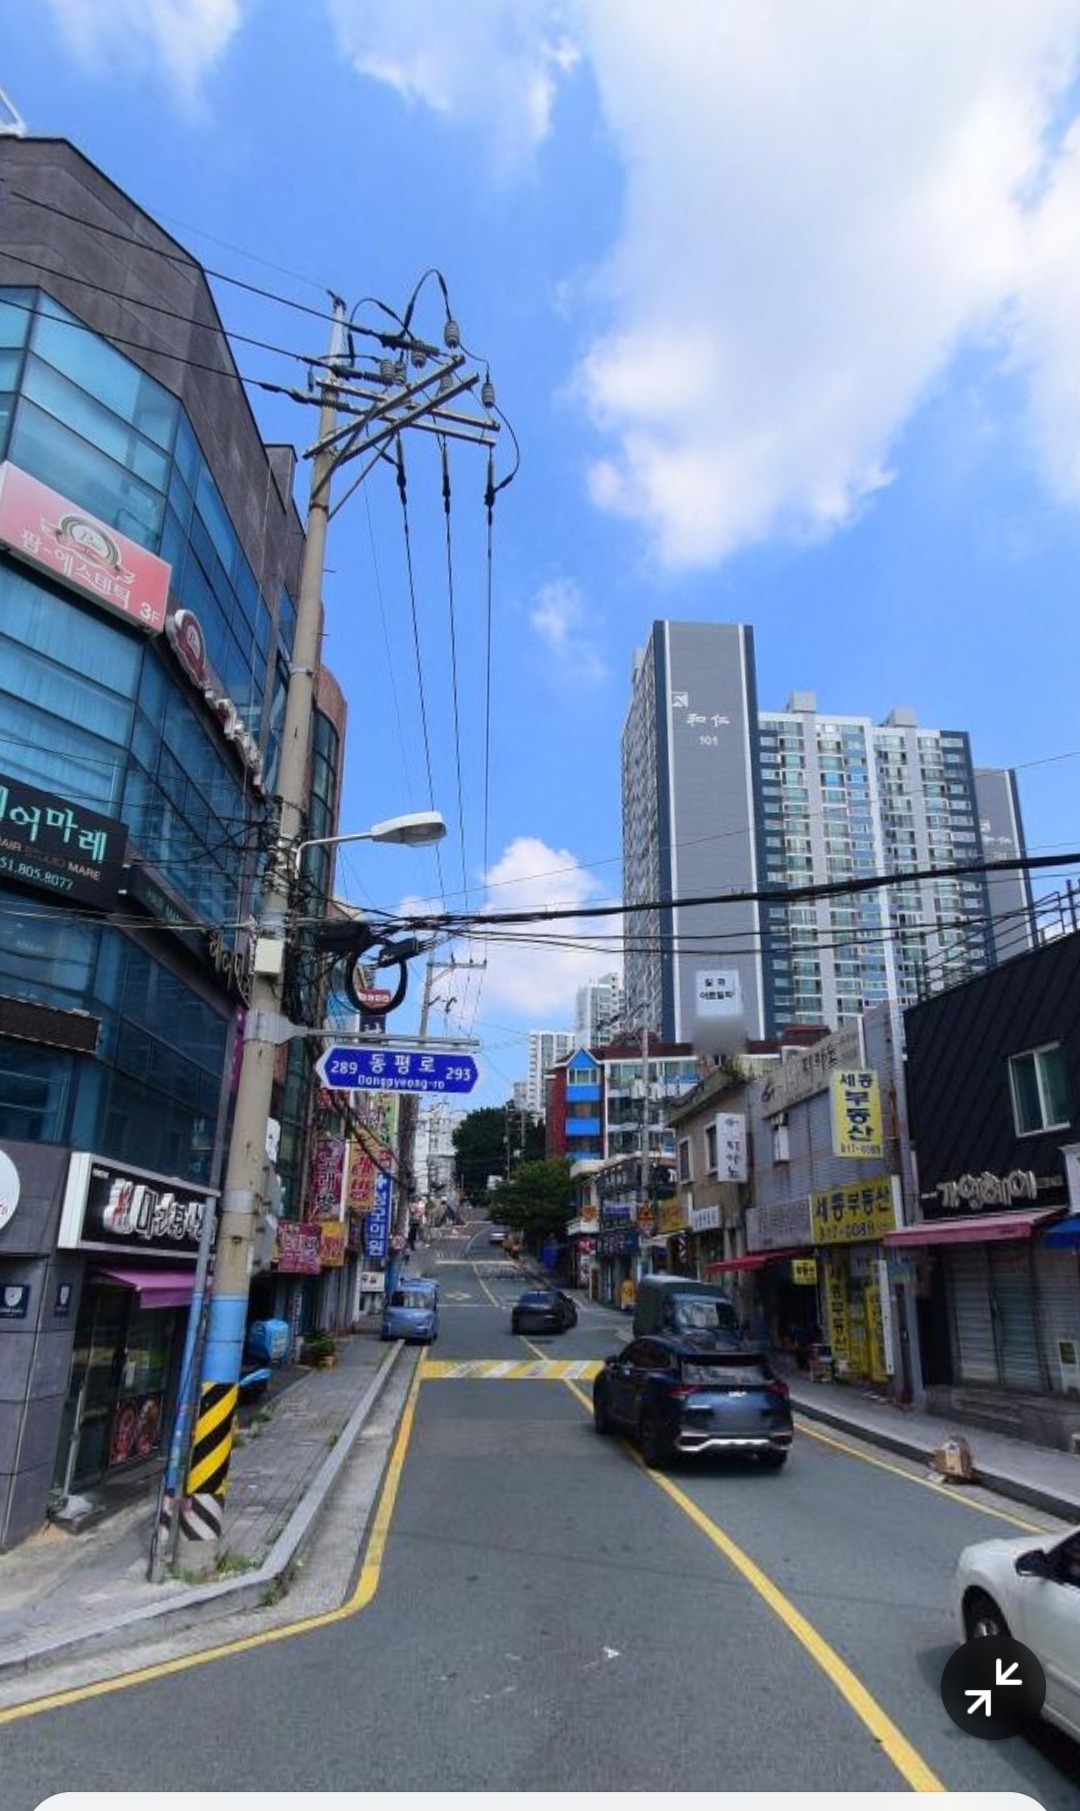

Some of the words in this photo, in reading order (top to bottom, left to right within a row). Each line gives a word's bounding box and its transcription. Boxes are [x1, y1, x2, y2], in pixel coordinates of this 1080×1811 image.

[139, 602, 161, 624] 3F
[699, 735, 718, 746] 101
[0, 837, 21, 851] AIR
[67, 861, 101, 880] MARE
[330, 1060, 358, 1075] 289
[369, 1053, 435, 1074] 동평로
[446, 1067, 471, 1081] 293
[845, 1090, 874, 1142] 부동산
